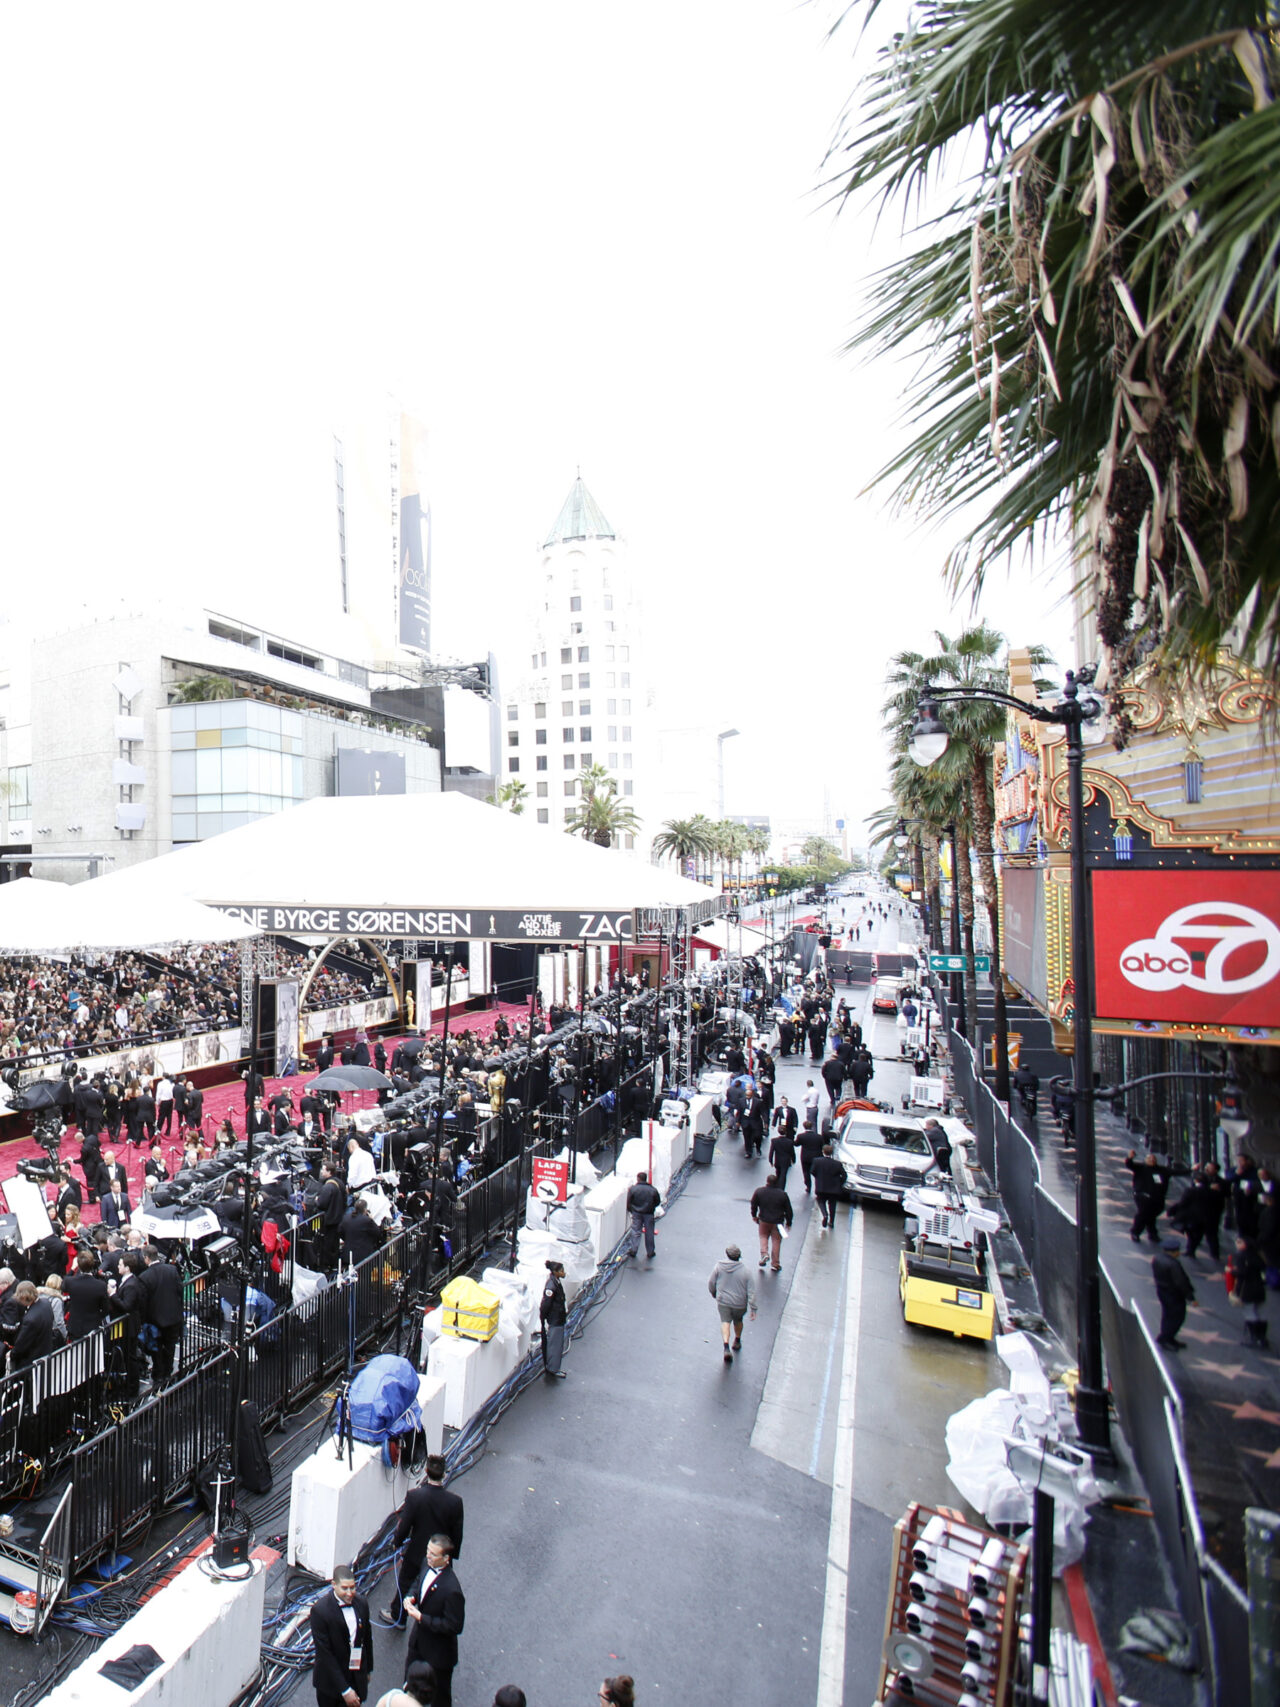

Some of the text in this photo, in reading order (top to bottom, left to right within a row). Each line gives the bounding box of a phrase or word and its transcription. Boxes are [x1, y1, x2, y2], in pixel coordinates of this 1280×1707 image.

[274, 909, 341, 931] BYRGE
[346, 910, 472, 935] SØRENSEN
[523, 914, 553, 923] CUTIE
[518, 921, 562, 930] AND THE
[526, 928, 561, 937] BOXER
[1122, 952, 1190, 974] abc
[538, 1161, 562, 1170] LAFD
